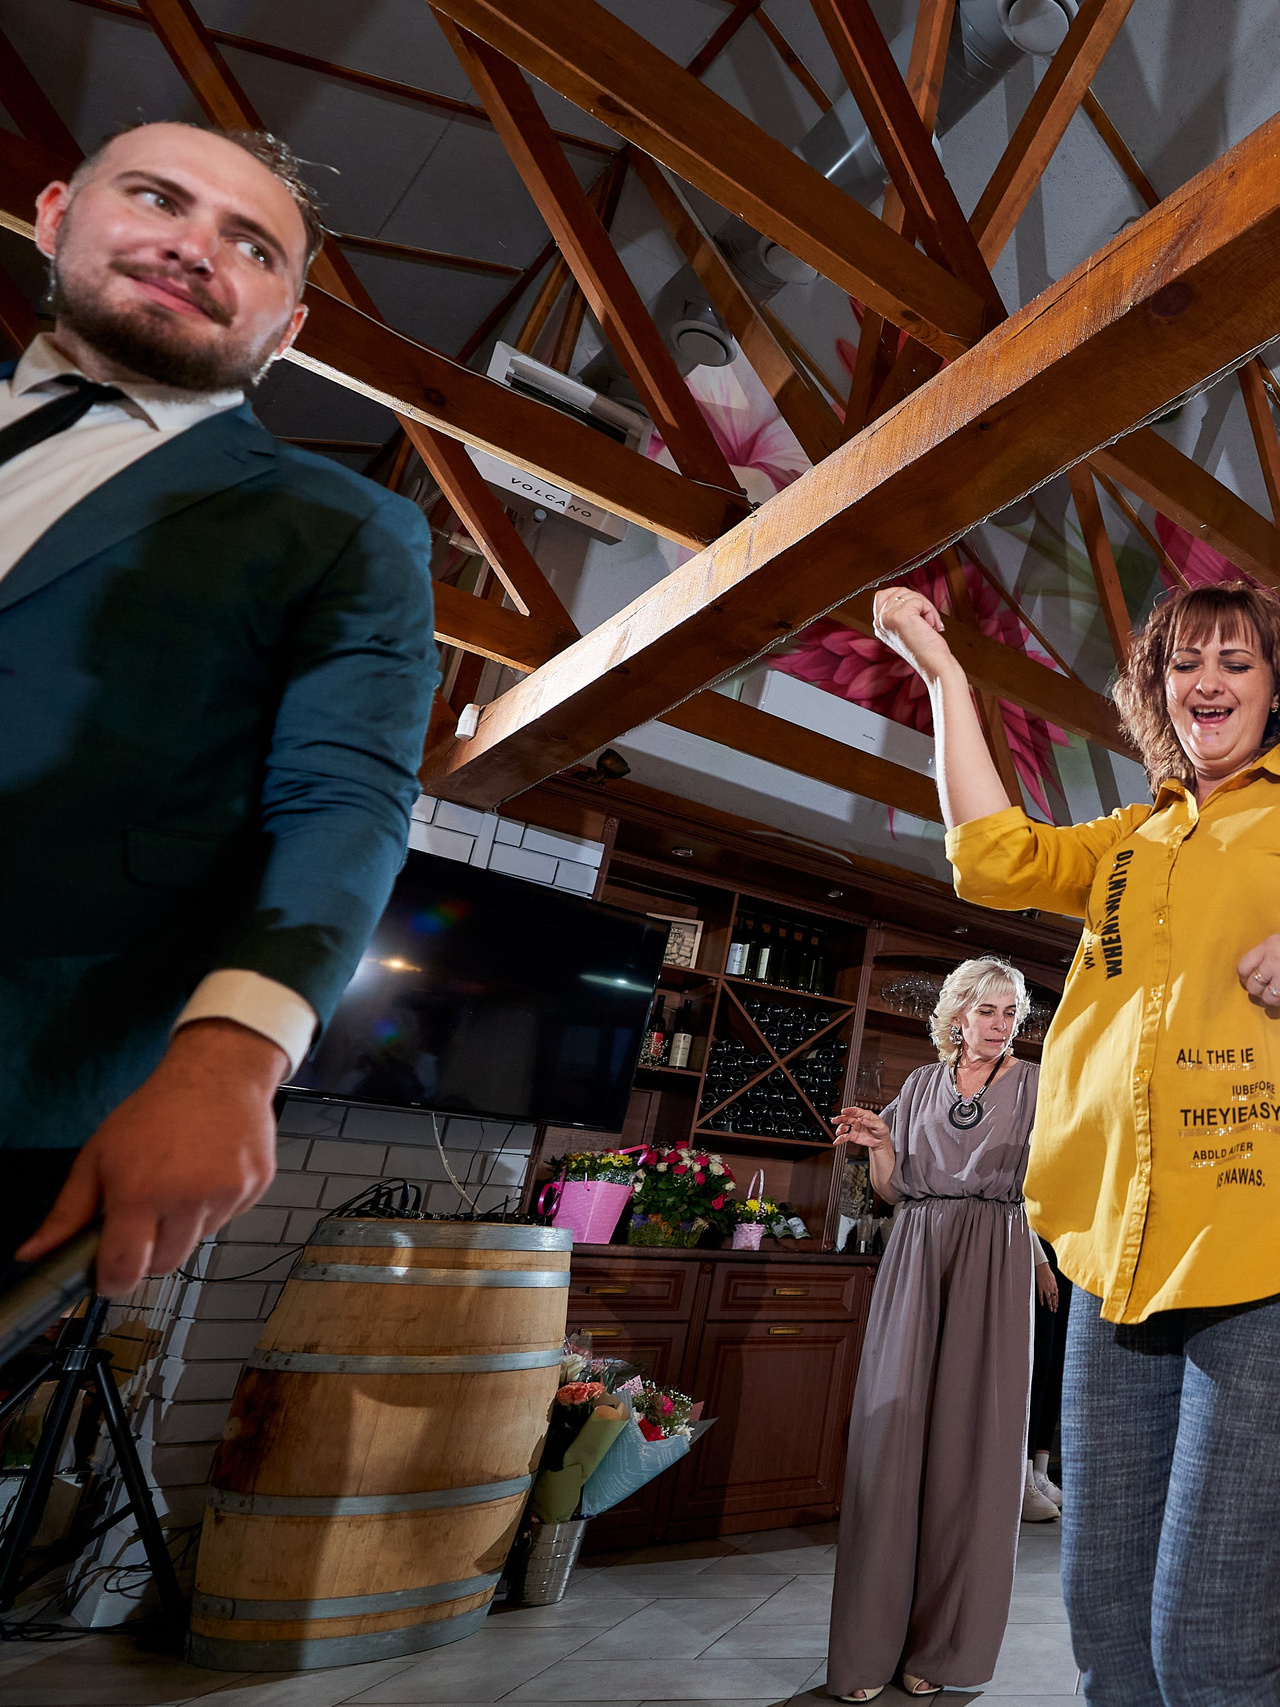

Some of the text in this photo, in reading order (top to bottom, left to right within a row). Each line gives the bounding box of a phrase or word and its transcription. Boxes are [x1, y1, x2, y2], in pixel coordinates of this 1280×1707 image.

[512, 477, 592, 517] VOLCANO
[1176, 1048, 1203, 1064] ALL
[1206, 1049, 1236, 1064] THE
